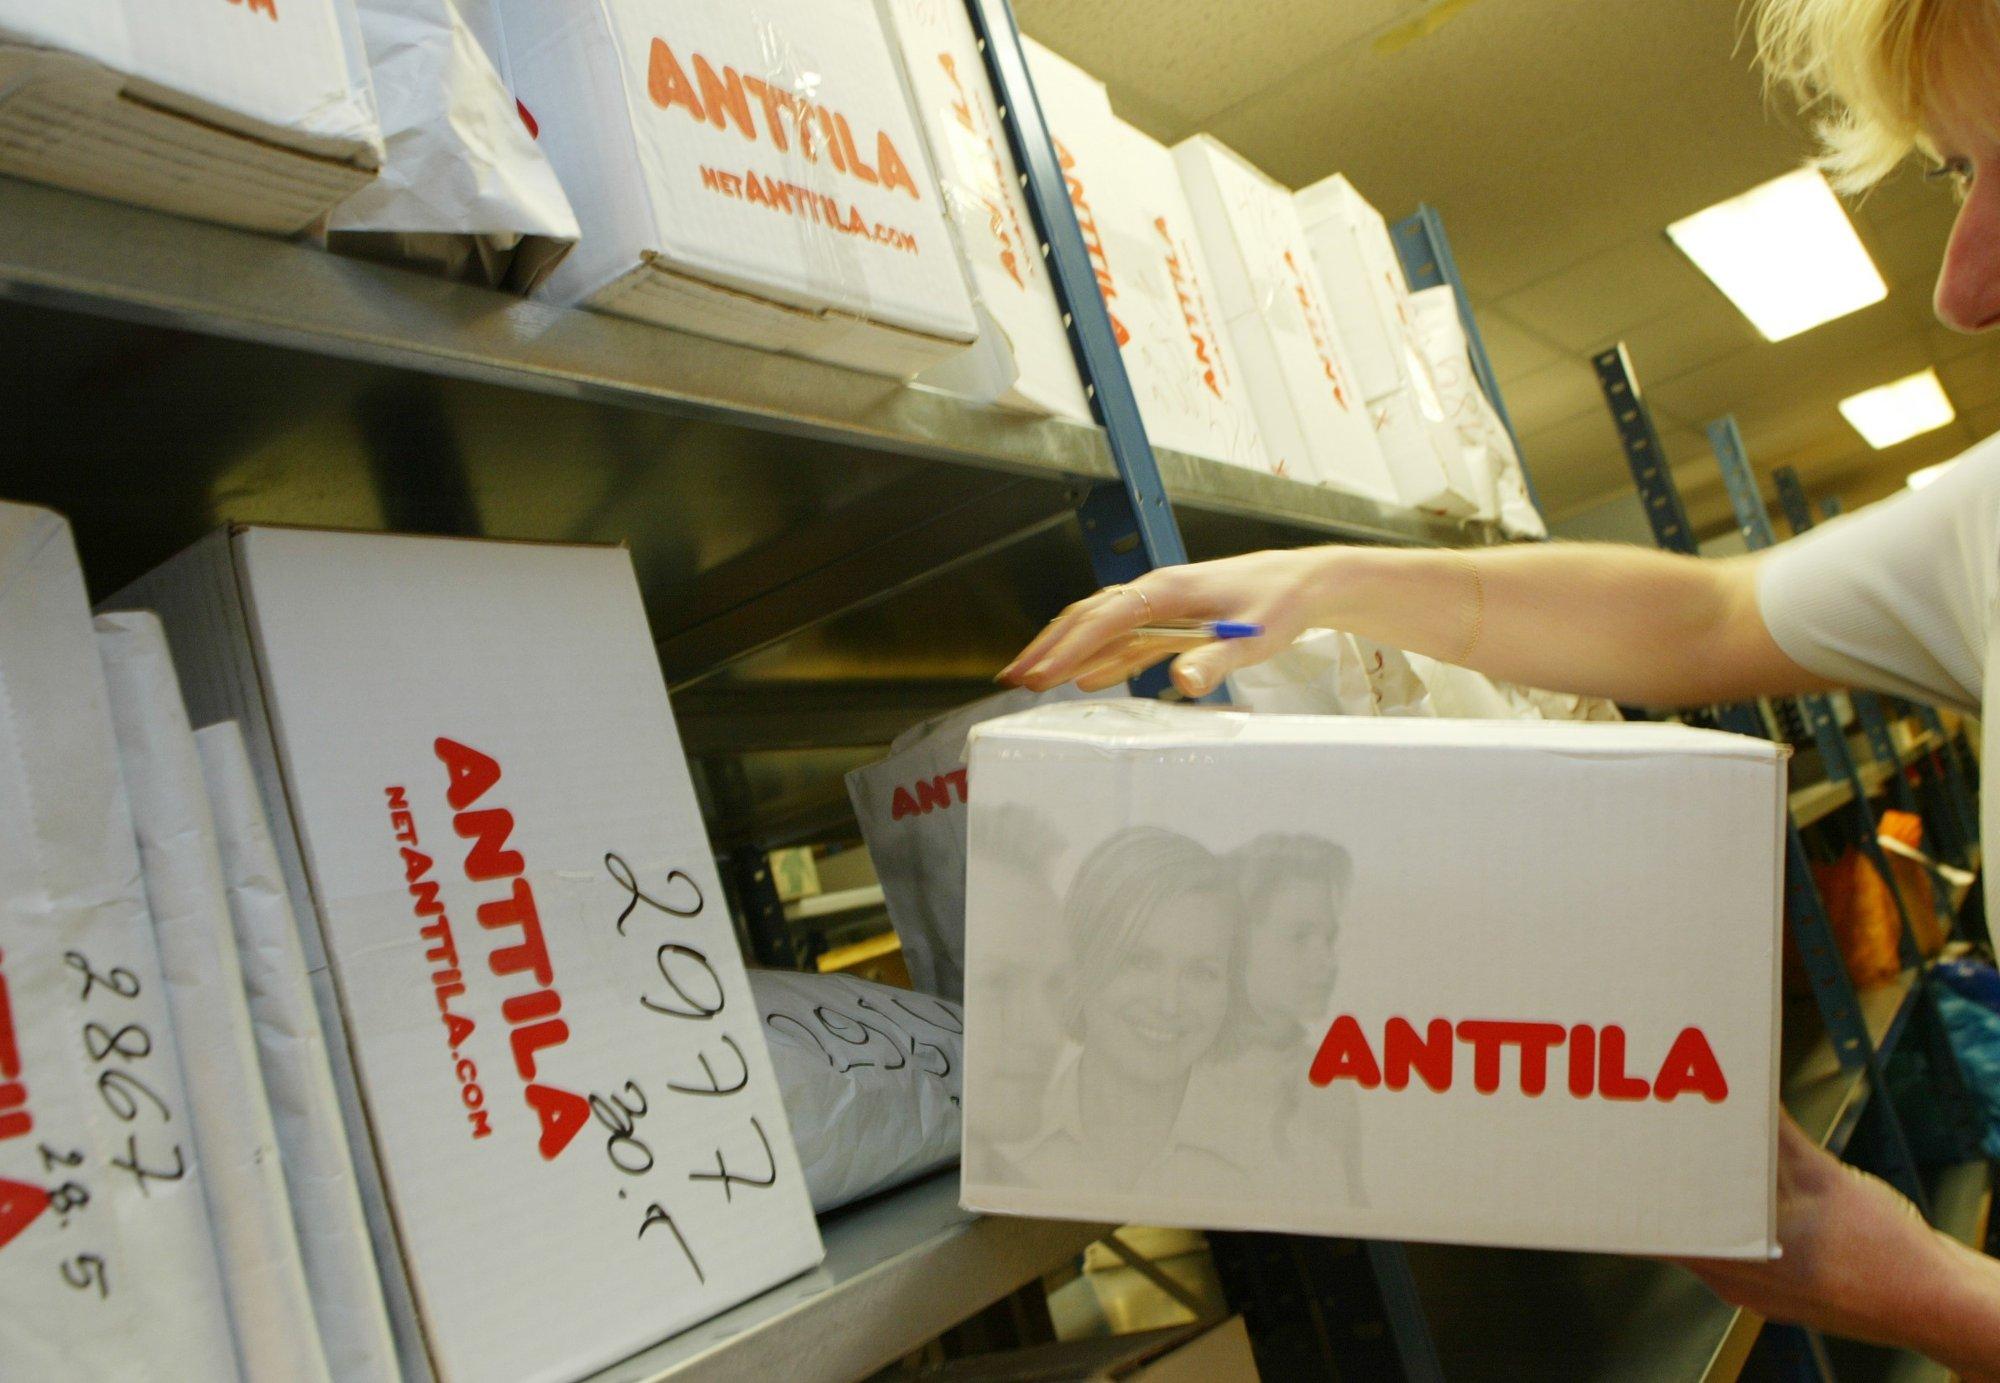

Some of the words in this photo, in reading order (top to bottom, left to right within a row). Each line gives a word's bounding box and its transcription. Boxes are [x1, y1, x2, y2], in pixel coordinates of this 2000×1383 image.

[648, 36, 919, 200] ANTTILA
[64, 950, 186, 1198] 2867
[385, 785, 493, 1140] NETANTTILA.COM
[433, 736, 592, 1161] ANTTILA
[604, 852, 777, 1203] 2977
[1308, 1014, 1729, 1104] ANTTILA
